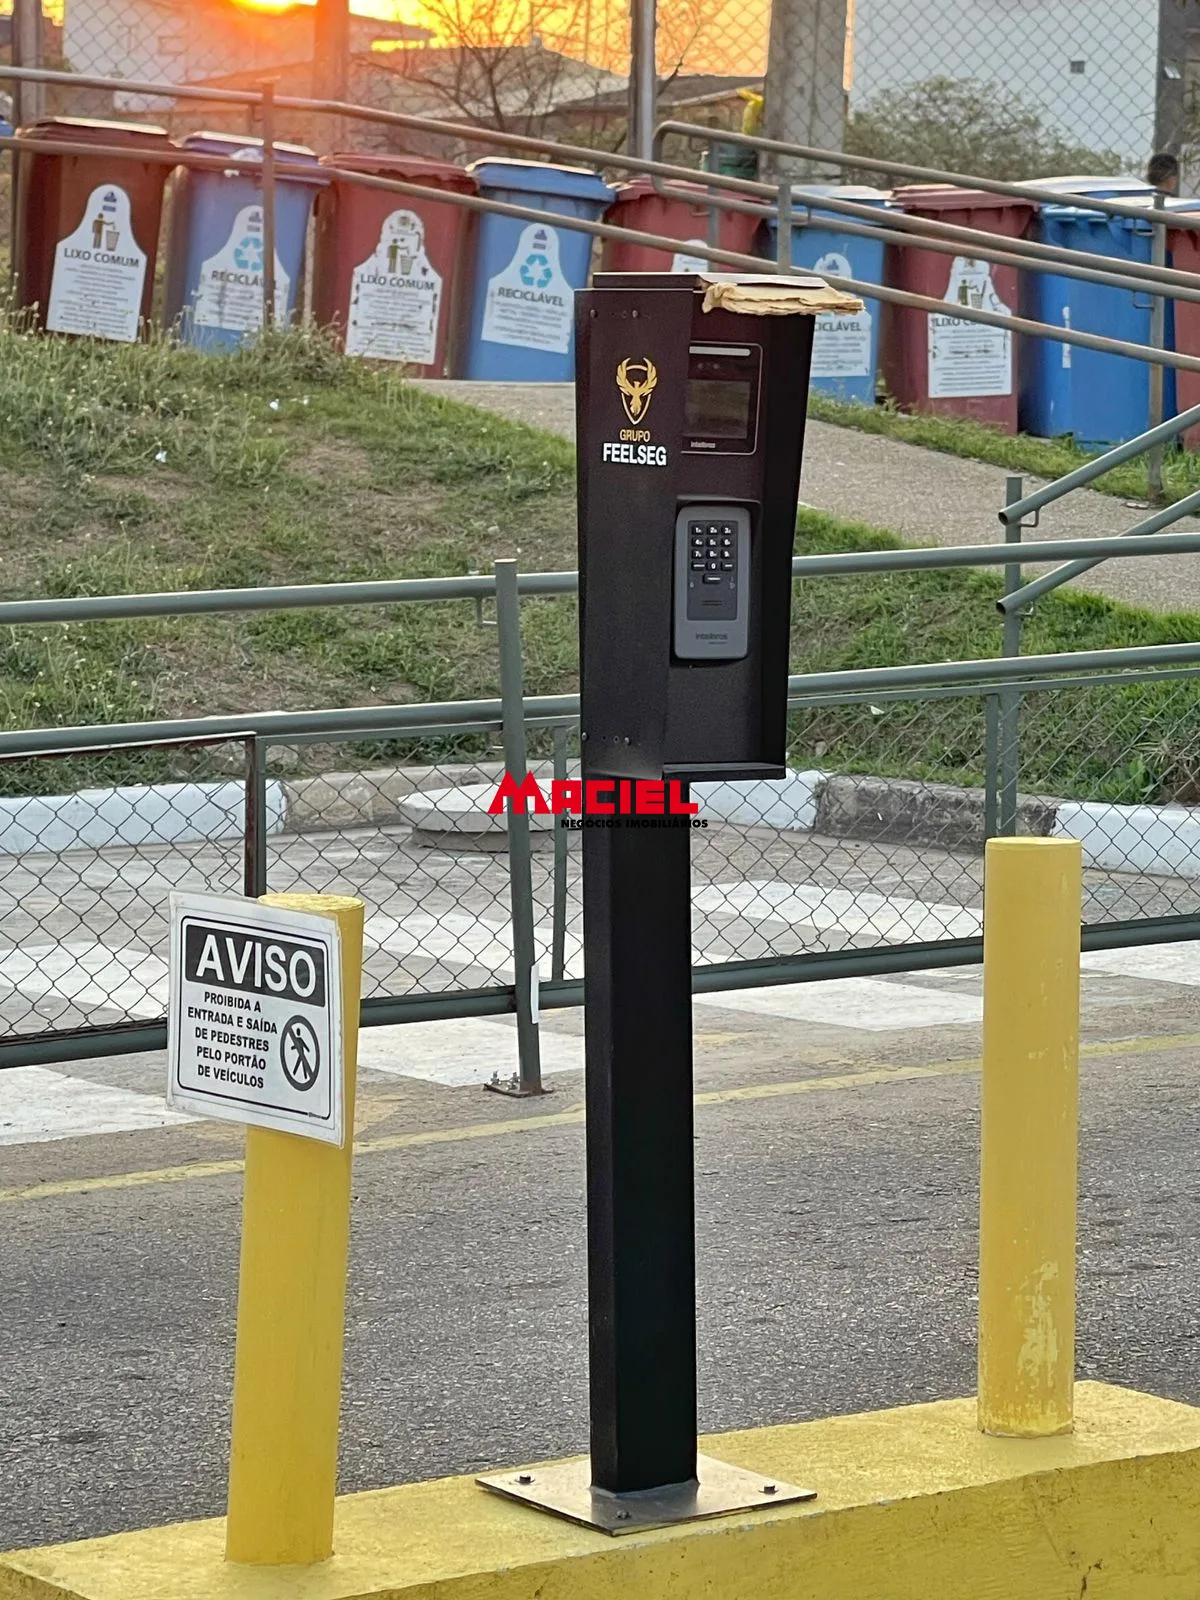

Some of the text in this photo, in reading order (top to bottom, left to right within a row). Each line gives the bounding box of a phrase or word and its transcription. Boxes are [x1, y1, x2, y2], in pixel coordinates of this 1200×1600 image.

[64, 247, 139, 268] LIXO COMUM
[360, 273, 435, 291] LIXO COMUM
[497, 286, 565, 307] RECICLÁVEL
[935, 317, 961, 327] LIXO
[619, 428, 651, 442] GRUPO
[603, 442, 667, 466] FEELSEG
[195, 934, 316, 997] AVISO
[204, 991, 262, 1013] PROIBIDA A
[187, 1006, 278, 1034] ENTRADA E SAÍDA
[195, 1026, 270, 1052] DE PEDESTRES
[196, 1045, 267, 1070] PELO PORTÃO
[197, 1064, 264, 1089] DE VEÍCULOS
